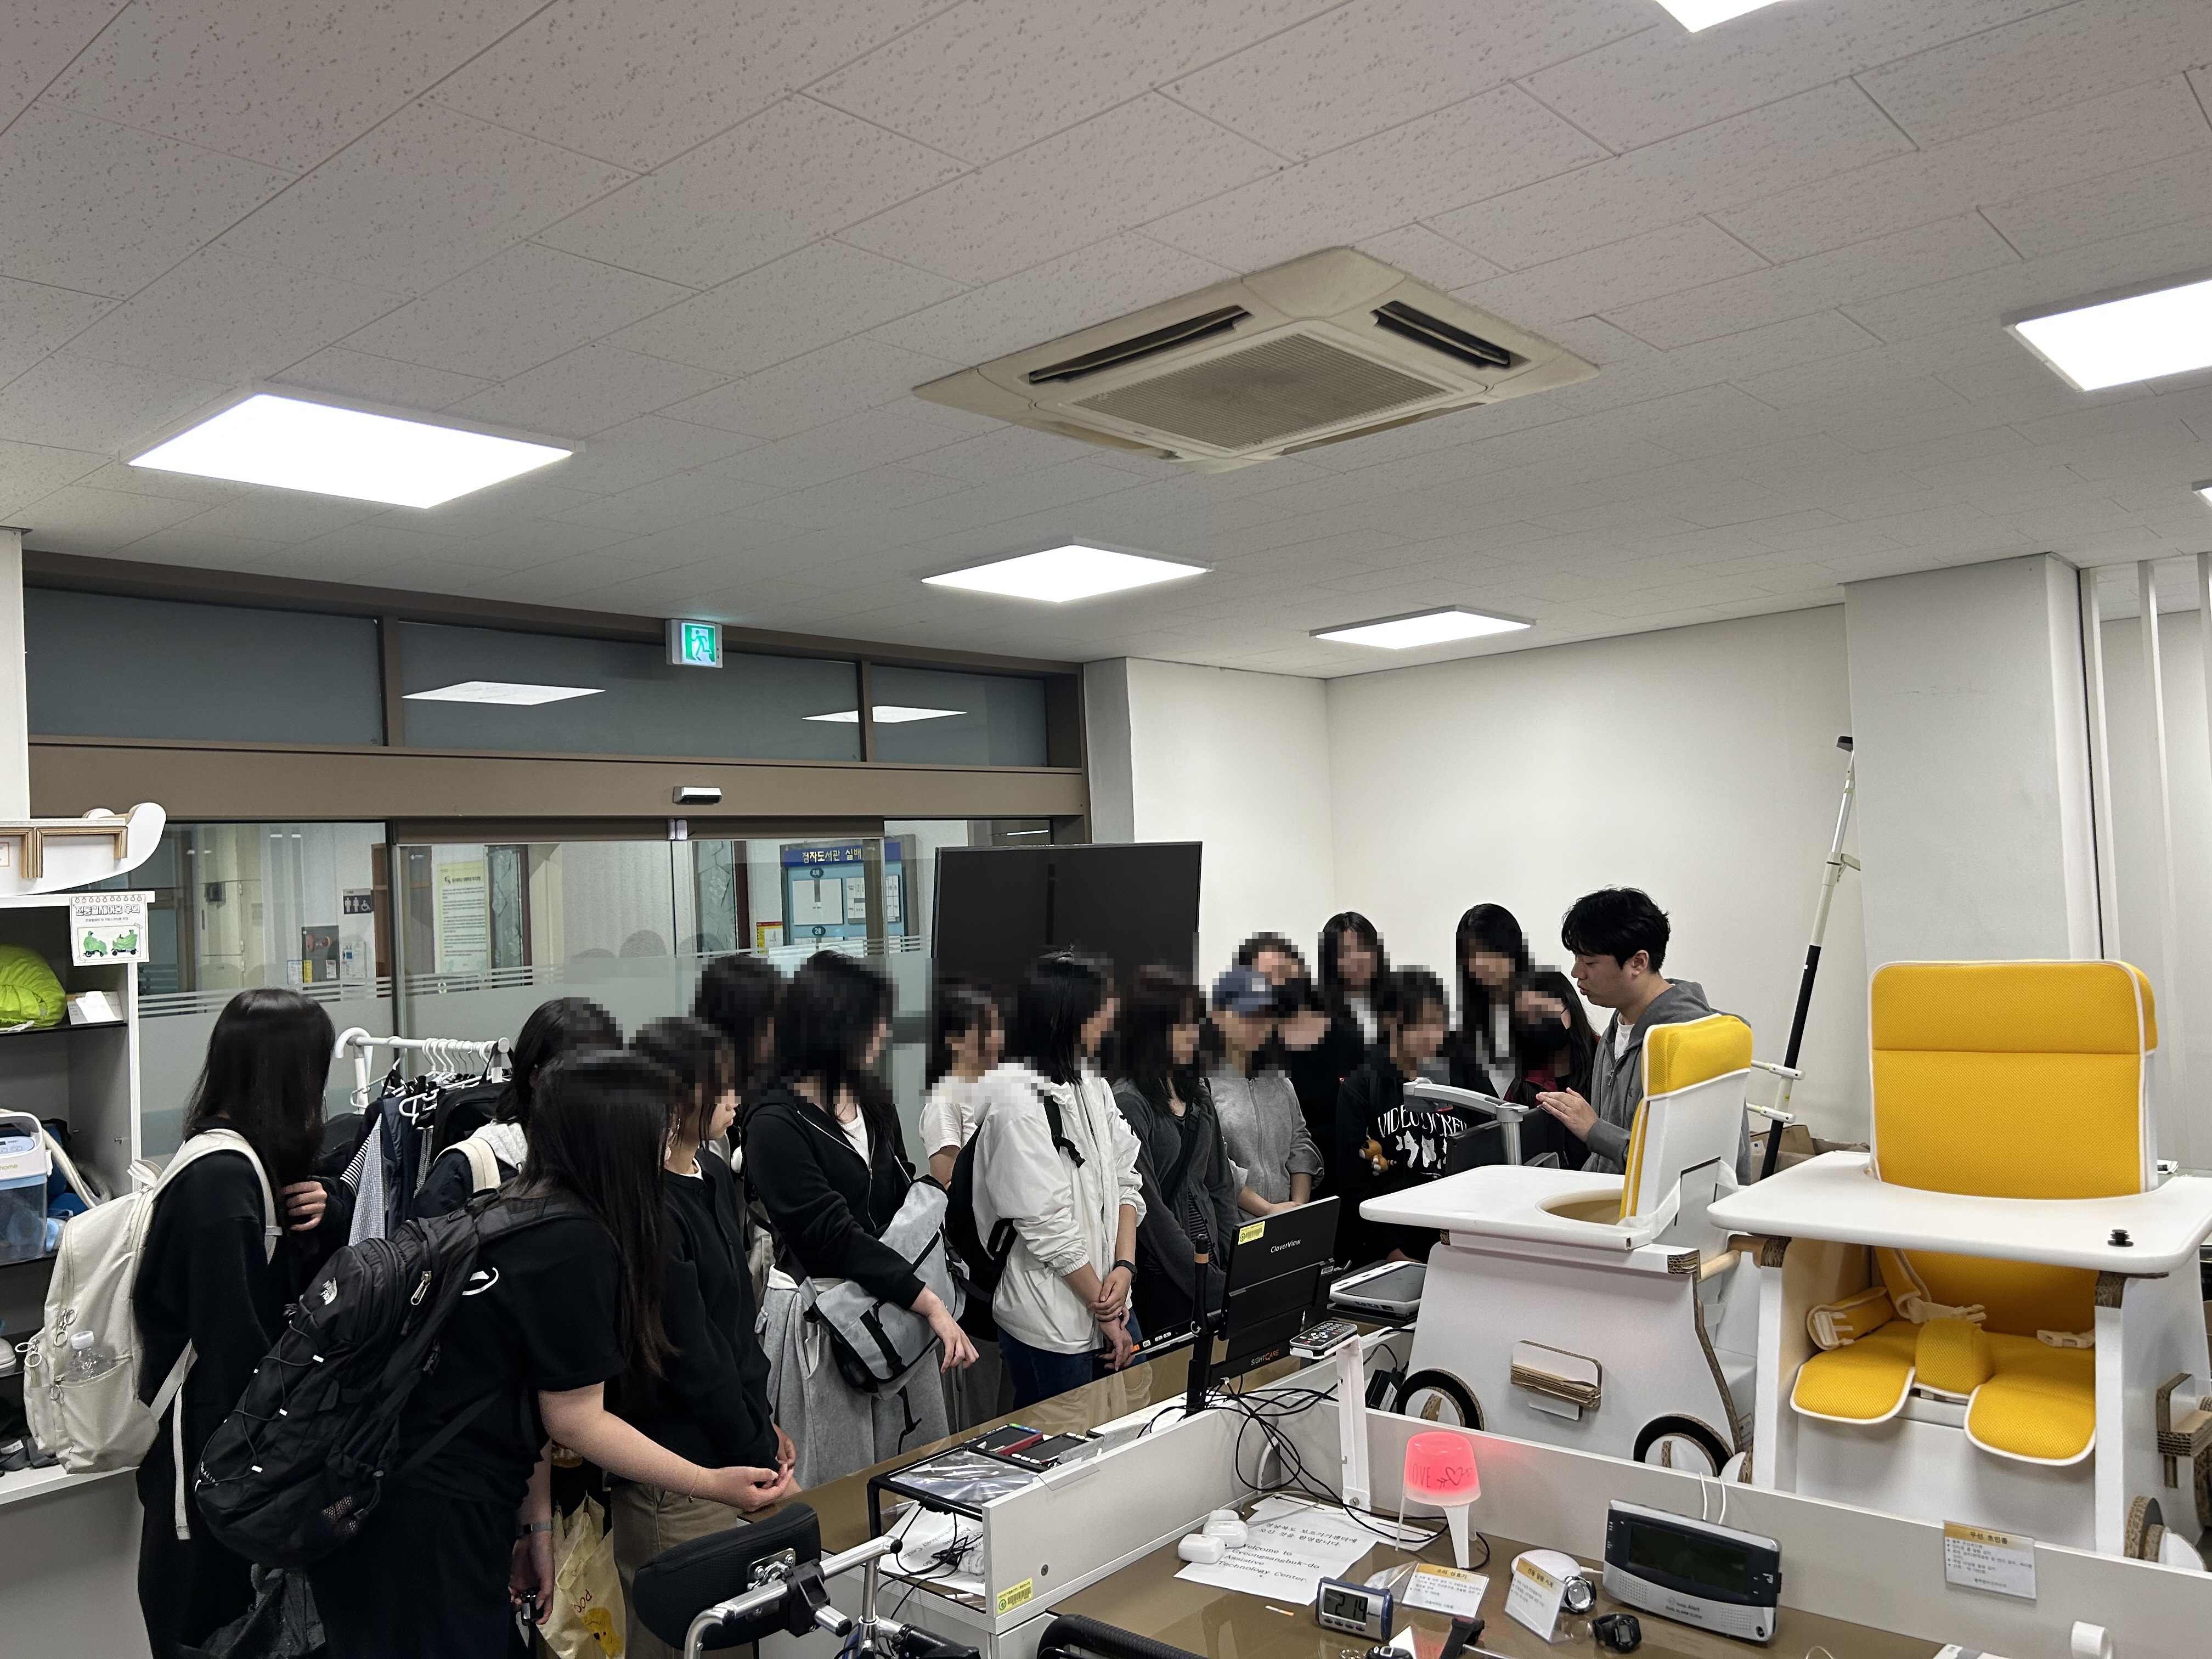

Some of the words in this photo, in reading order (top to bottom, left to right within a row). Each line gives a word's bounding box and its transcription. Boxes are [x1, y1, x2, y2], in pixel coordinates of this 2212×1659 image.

[802, 850, 840, 864] 점자도서관
[845, 848, 864, 860] 실배
[76, 905, 123, 916] 전동휠체어용
[124, 904, 140, 914] 우의
[1271, 1239, 1301, 1253] CloverView
[1250, 1349, 1279, 1366] SIGHTCARE
[1408, 1462, 1431, 1488] LOVE
[1224, 1555, 1265, 1566] Assistive
[1232, 1549, 1320, 1569] Gyeongsangbuk-do
[1218, 1560, 1271, 1575] Technology
